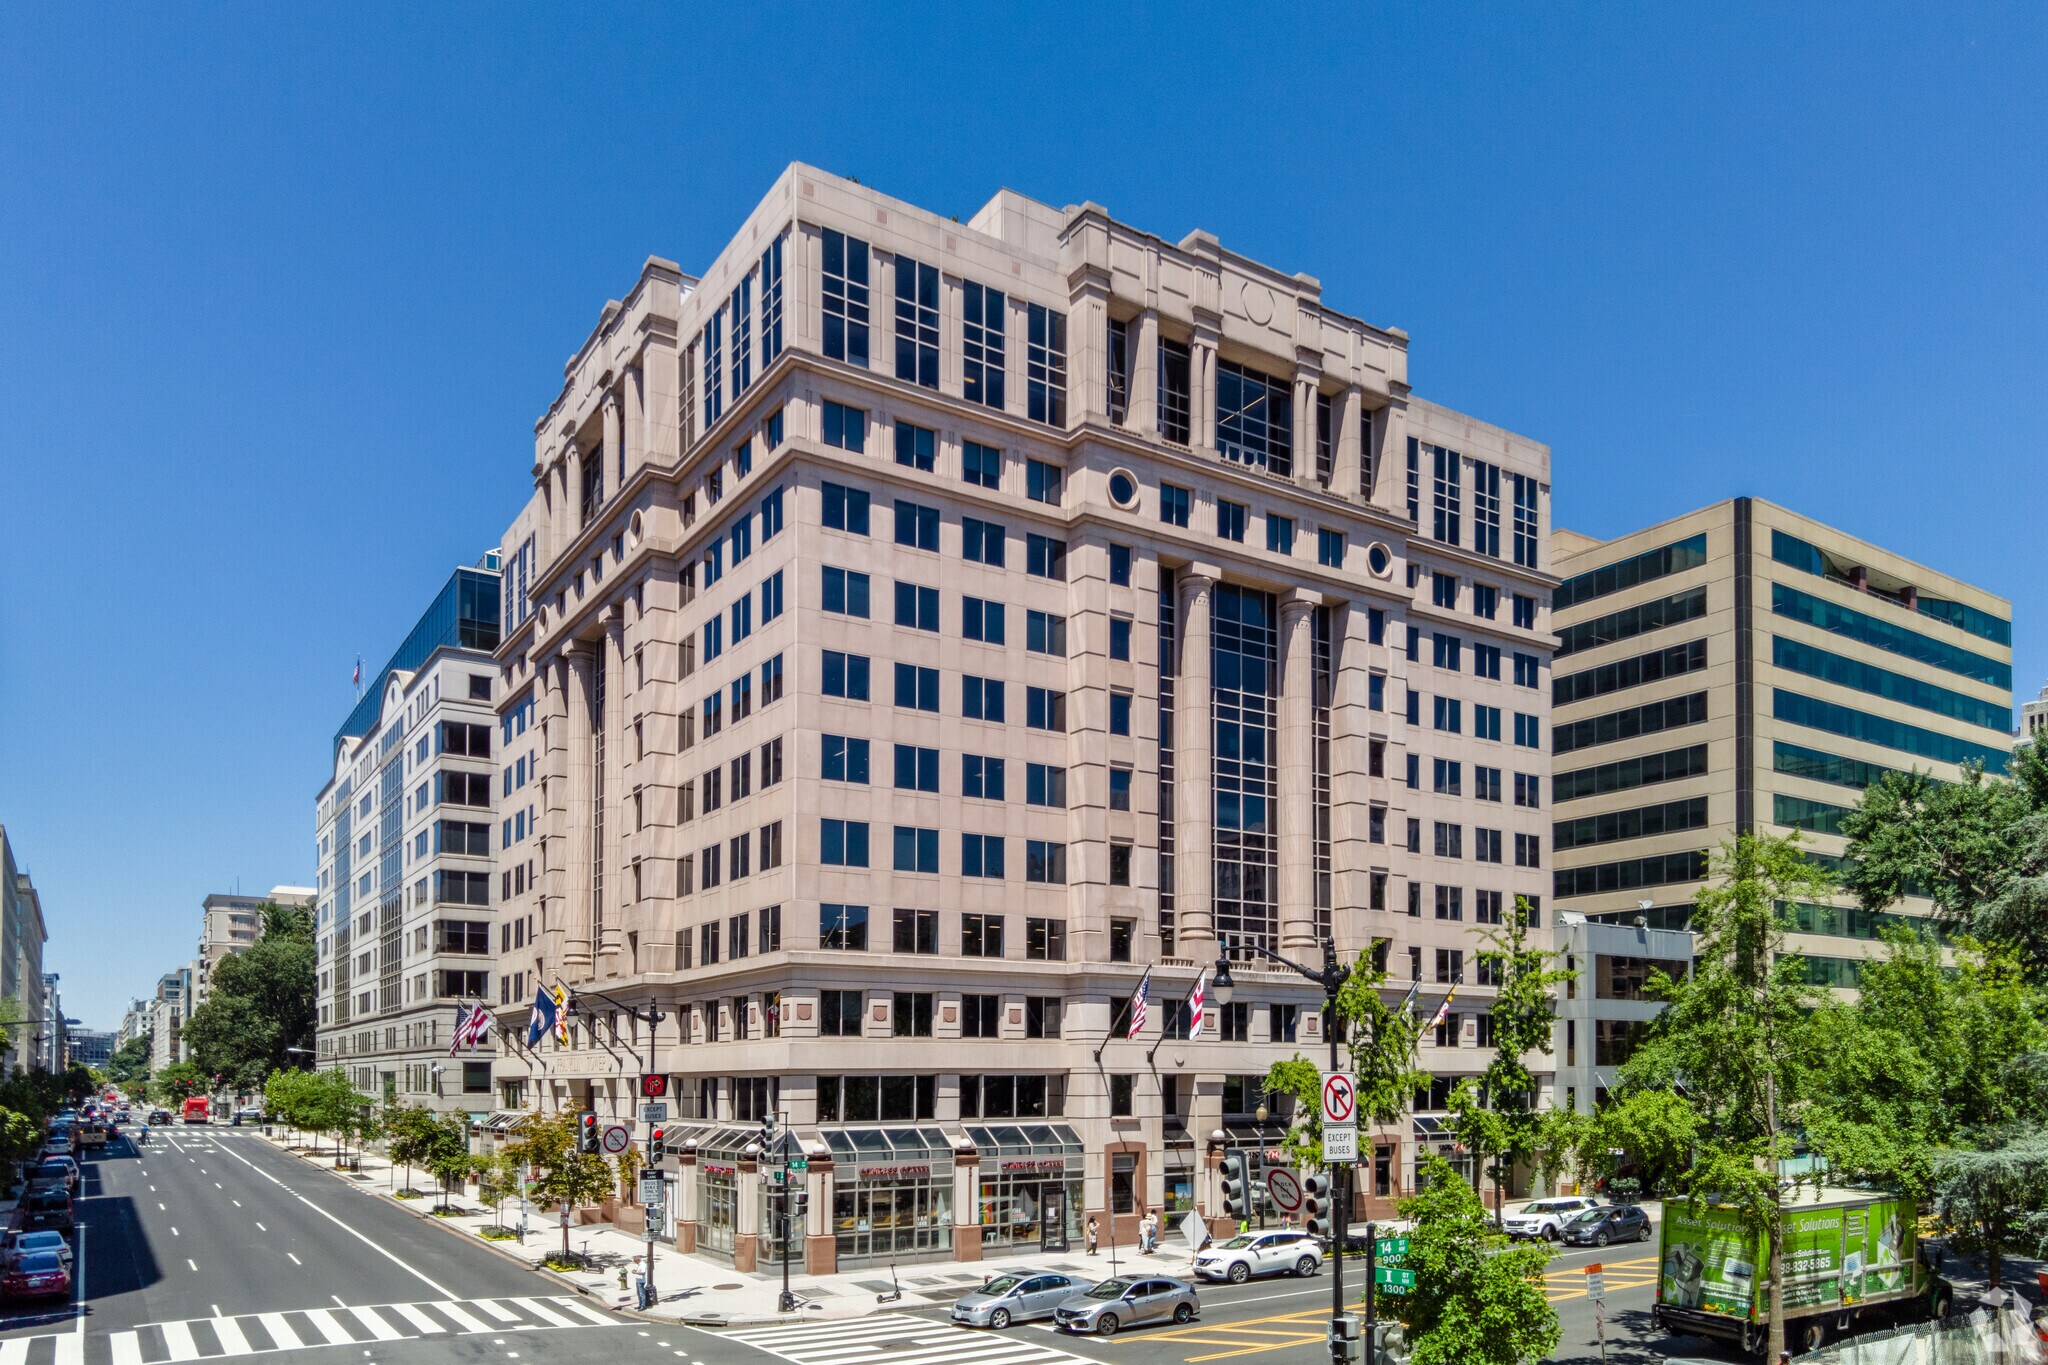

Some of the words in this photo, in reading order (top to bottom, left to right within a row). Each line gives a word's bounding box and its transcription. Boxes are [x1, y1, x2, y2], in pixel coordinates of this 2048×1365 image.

[1328, 1133, 1351, 1142] EXCEPT
[1329, 1145, 1351, 1154] BUSES
[1676, 1216, 1702, 1227] Asset
[1706, 1219, 1748, 1233] Solution
[1799, 1216, 1840, 1233] Solutions
[1380, 1241, 1392, 1254] 14
[1383, 1254, 1402, 1264] 900
[1781, 1256, 1831, 1275] 88-832-5865
[1383, 1284, 1405, 1294] 1300
